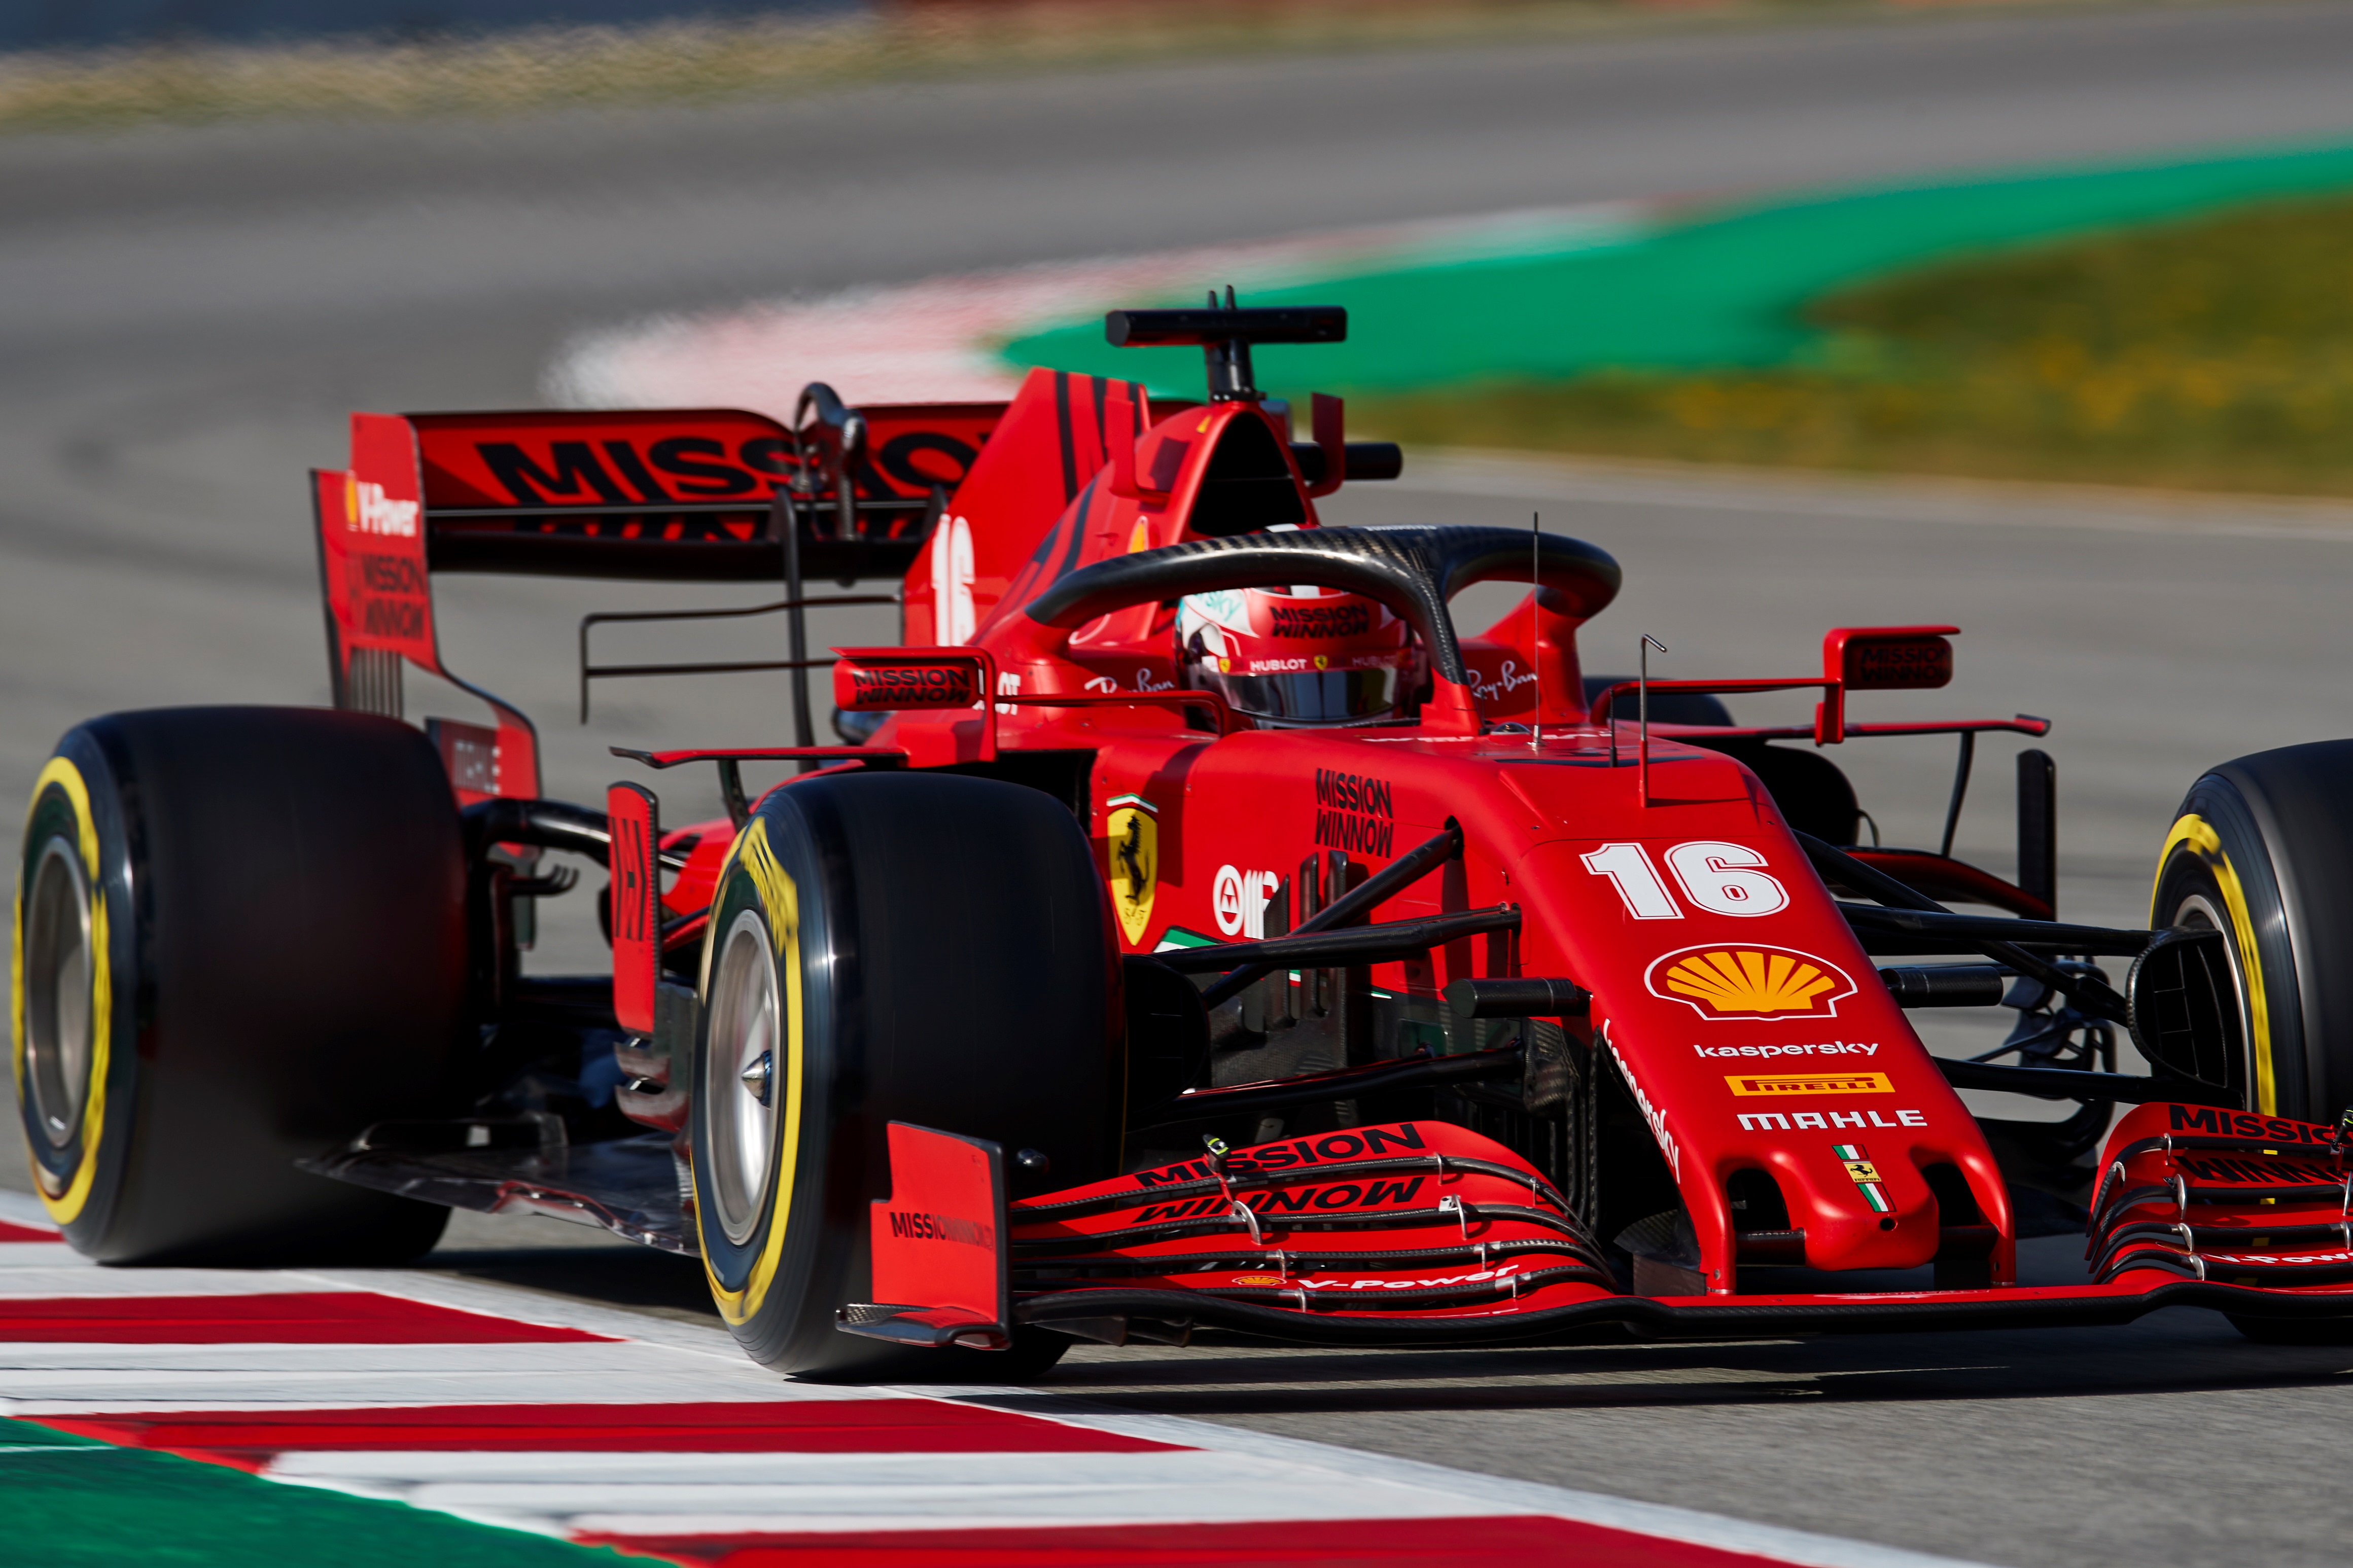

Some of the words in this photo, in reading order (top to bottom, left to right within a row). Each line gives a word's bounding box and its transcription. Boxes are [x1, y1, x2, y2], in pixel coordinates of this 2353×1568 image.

[473, 433, 992, 503] MISSIO
[1269, 603, 1368, 622] MISSION
[1271, 621, 1368, 638] WINNOW
[1249, 659, 1307, 672] HUBLOT
[853, 669, 970, 688] MISSION
[856, 687, 972, 705] WINNOW
[1316, 768, 1394, 819] MISSION
[1315, 808, 1394, 859] WINNOW
[1579, 841, 1790, 920] 16
[1693, 1041, 1879, 1058] kaspersky
[1740, 1077, 1878, 1092] PIRELLI
[1736, 1110, 1927, 1130] MAHLE
[2168, 1104, 2353, 1145] MISSIO
[1134, 1122, 1426, 1188] MISSION
[2173, 1155, 2353, 1184] WINNO
[1131, 1177, 1425, 1224] WINNOW
[1297, 1264, 1520, 1289] V-Power
